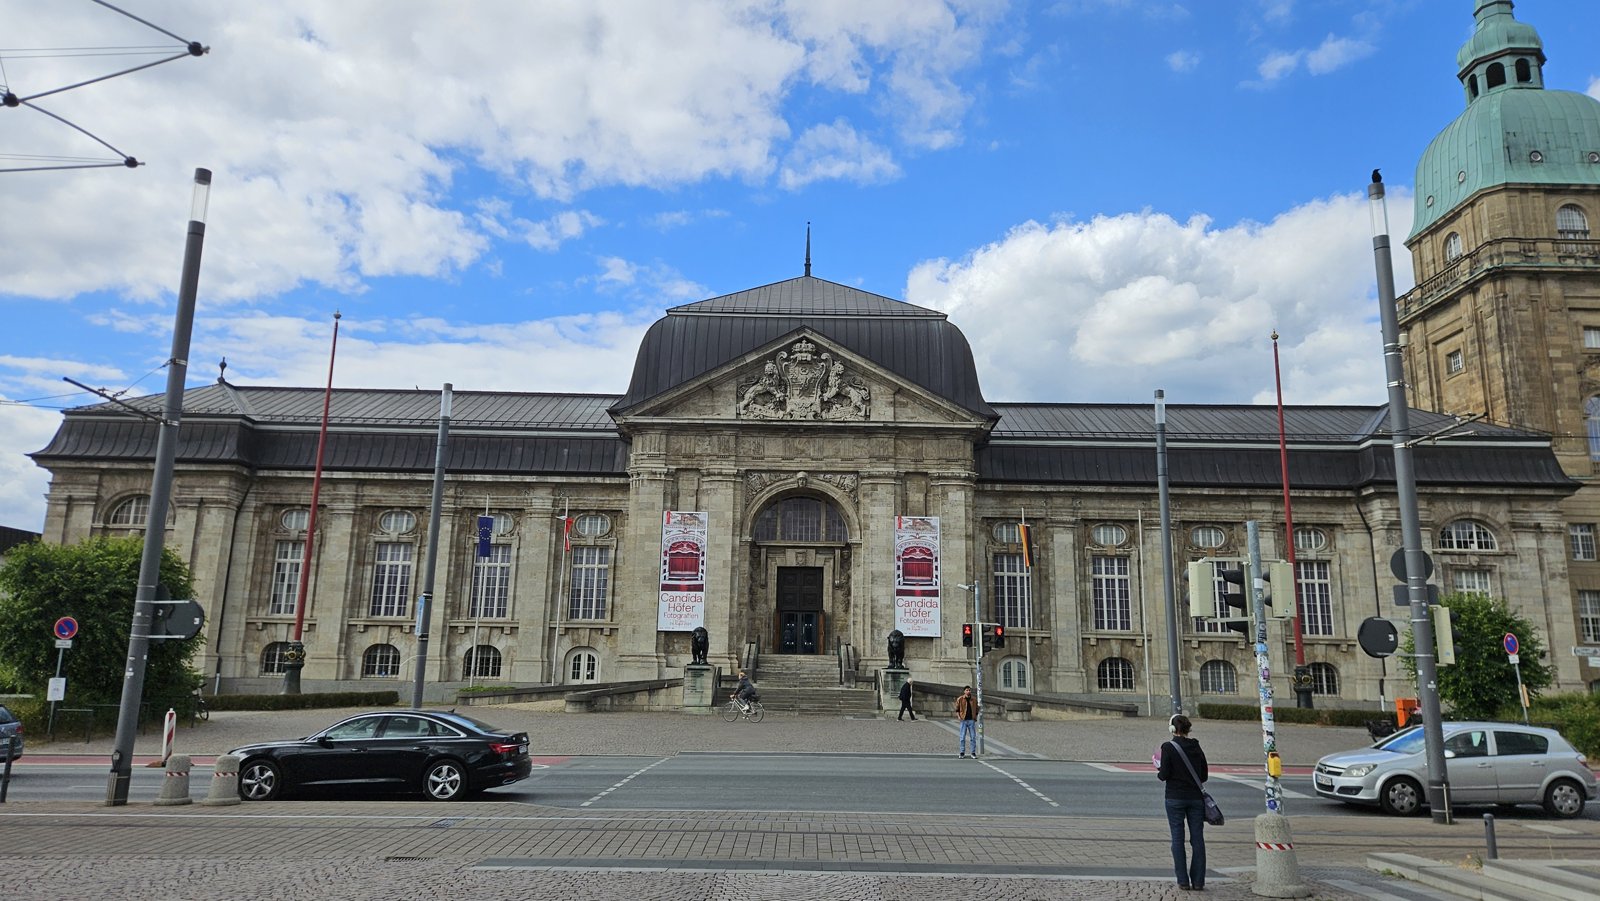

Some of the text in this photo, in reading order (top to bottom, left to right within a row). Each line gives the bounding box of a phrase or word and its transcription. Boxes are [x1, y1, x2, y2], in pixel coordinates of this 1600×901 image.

[661, 593, 702, 602] Candida
[668, 603, 696, 612] Höfer
[896, 598, 939, 608] Candida
[904, 608, 932, 618] Höfer
